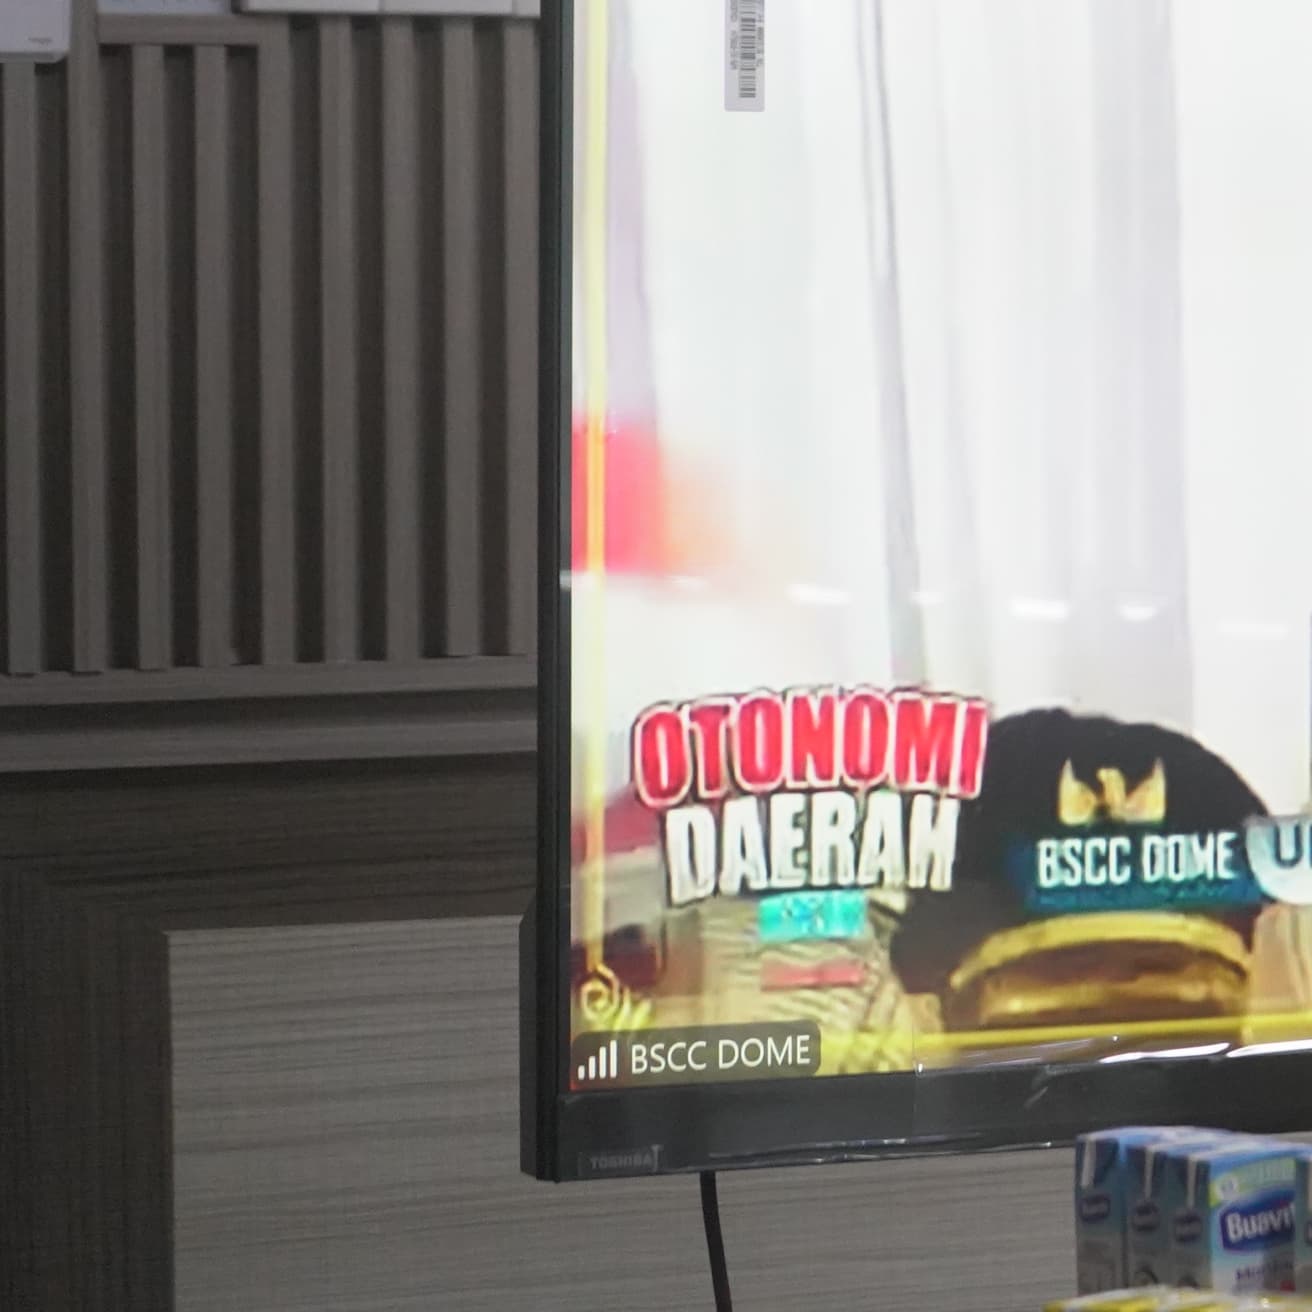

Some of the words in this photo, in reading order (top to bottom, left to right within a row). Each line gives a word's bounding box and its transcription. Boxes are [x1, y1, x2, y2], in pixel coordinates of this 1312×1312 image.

[632, 689, 988, 809] OTONOMI
[664, 790, 962, 908] DAERAH
[1037, 836, 1132, 889] BSCC
[1142, 830, 1238, 883] DOME
[630, 1041, 708, 1075] BSCC
[718, 1034, 811, 1070] DOME
